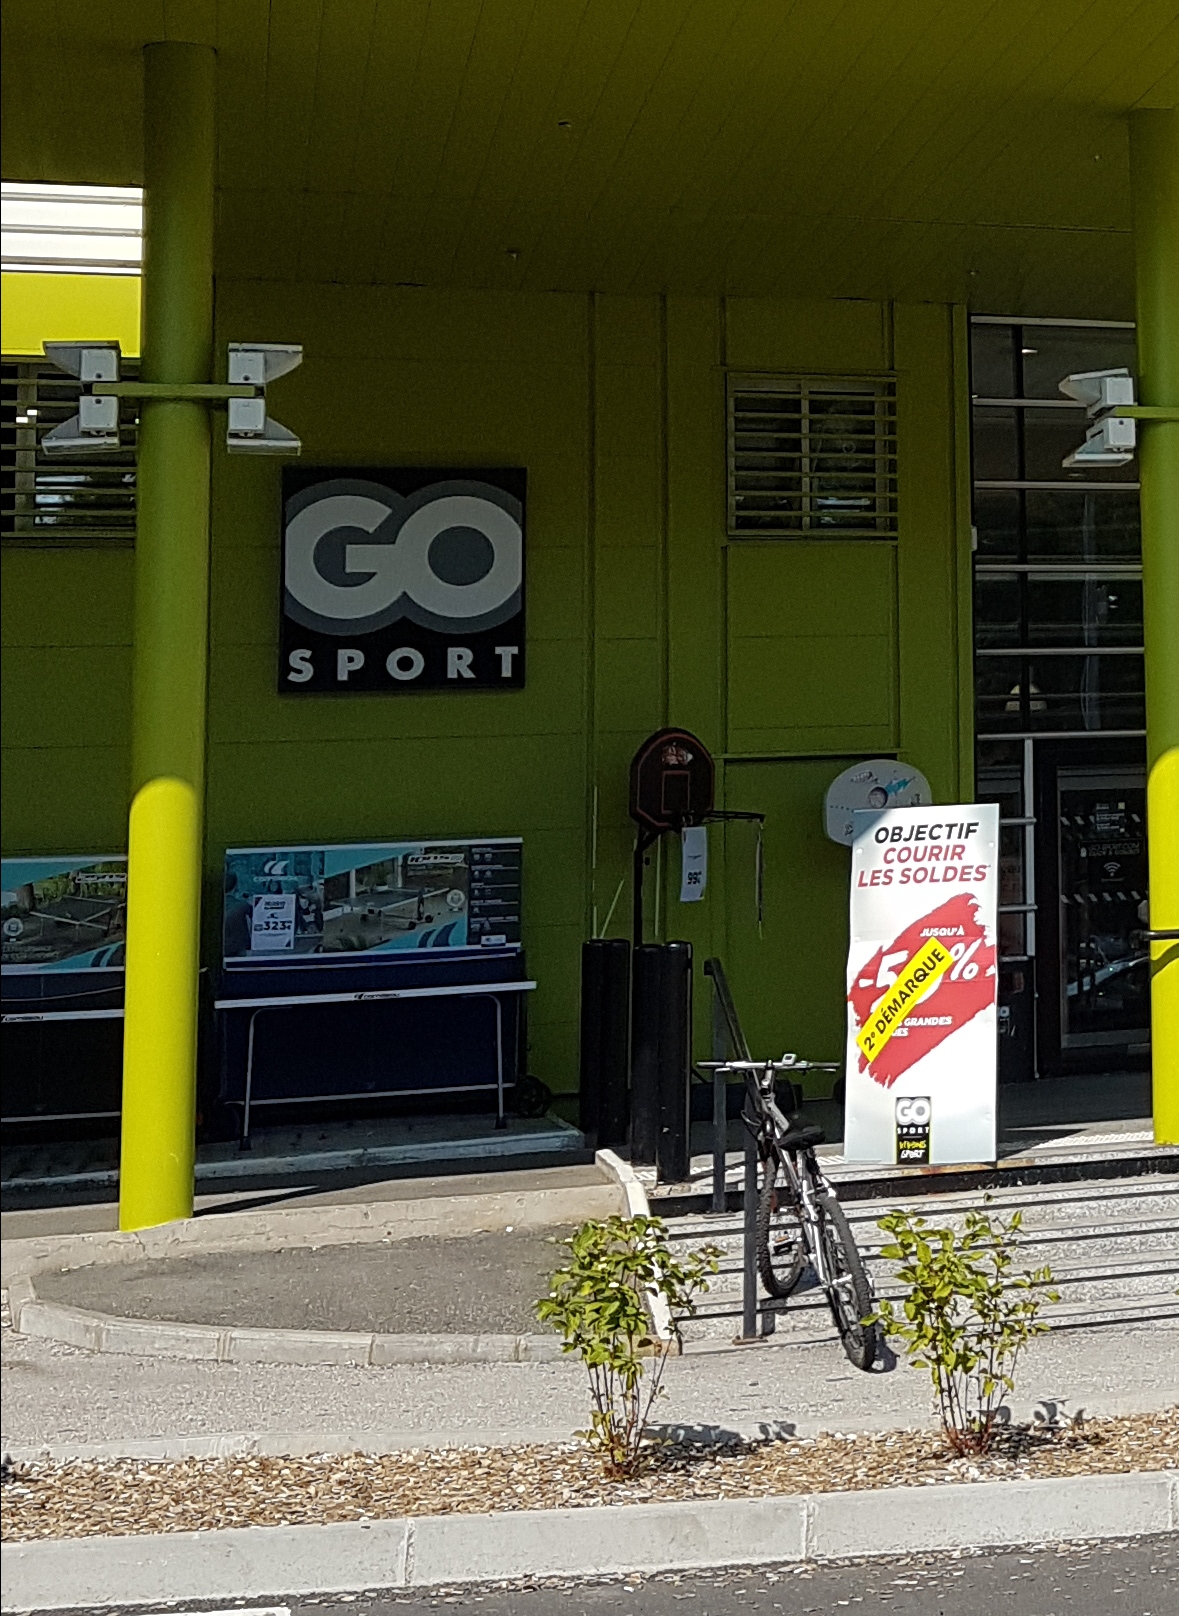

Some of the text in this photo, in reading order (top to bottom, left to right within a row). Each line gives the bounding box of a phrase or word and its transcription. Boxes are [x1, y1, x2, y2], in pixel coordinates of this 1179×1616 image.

[285, 494, 523, 620] GO
[287, 646, 519, 683] SPORT
[874, 821, 980, 844] OBJECTIF
[883, 844, 966, 864] COURIR
[858, 868, 894, 887] LES
[874, 947, 946, 1036] DÉMARQUE
[896, 1097, 931, 1125] GO
[897, 1126, 930, 1134] SPORT
